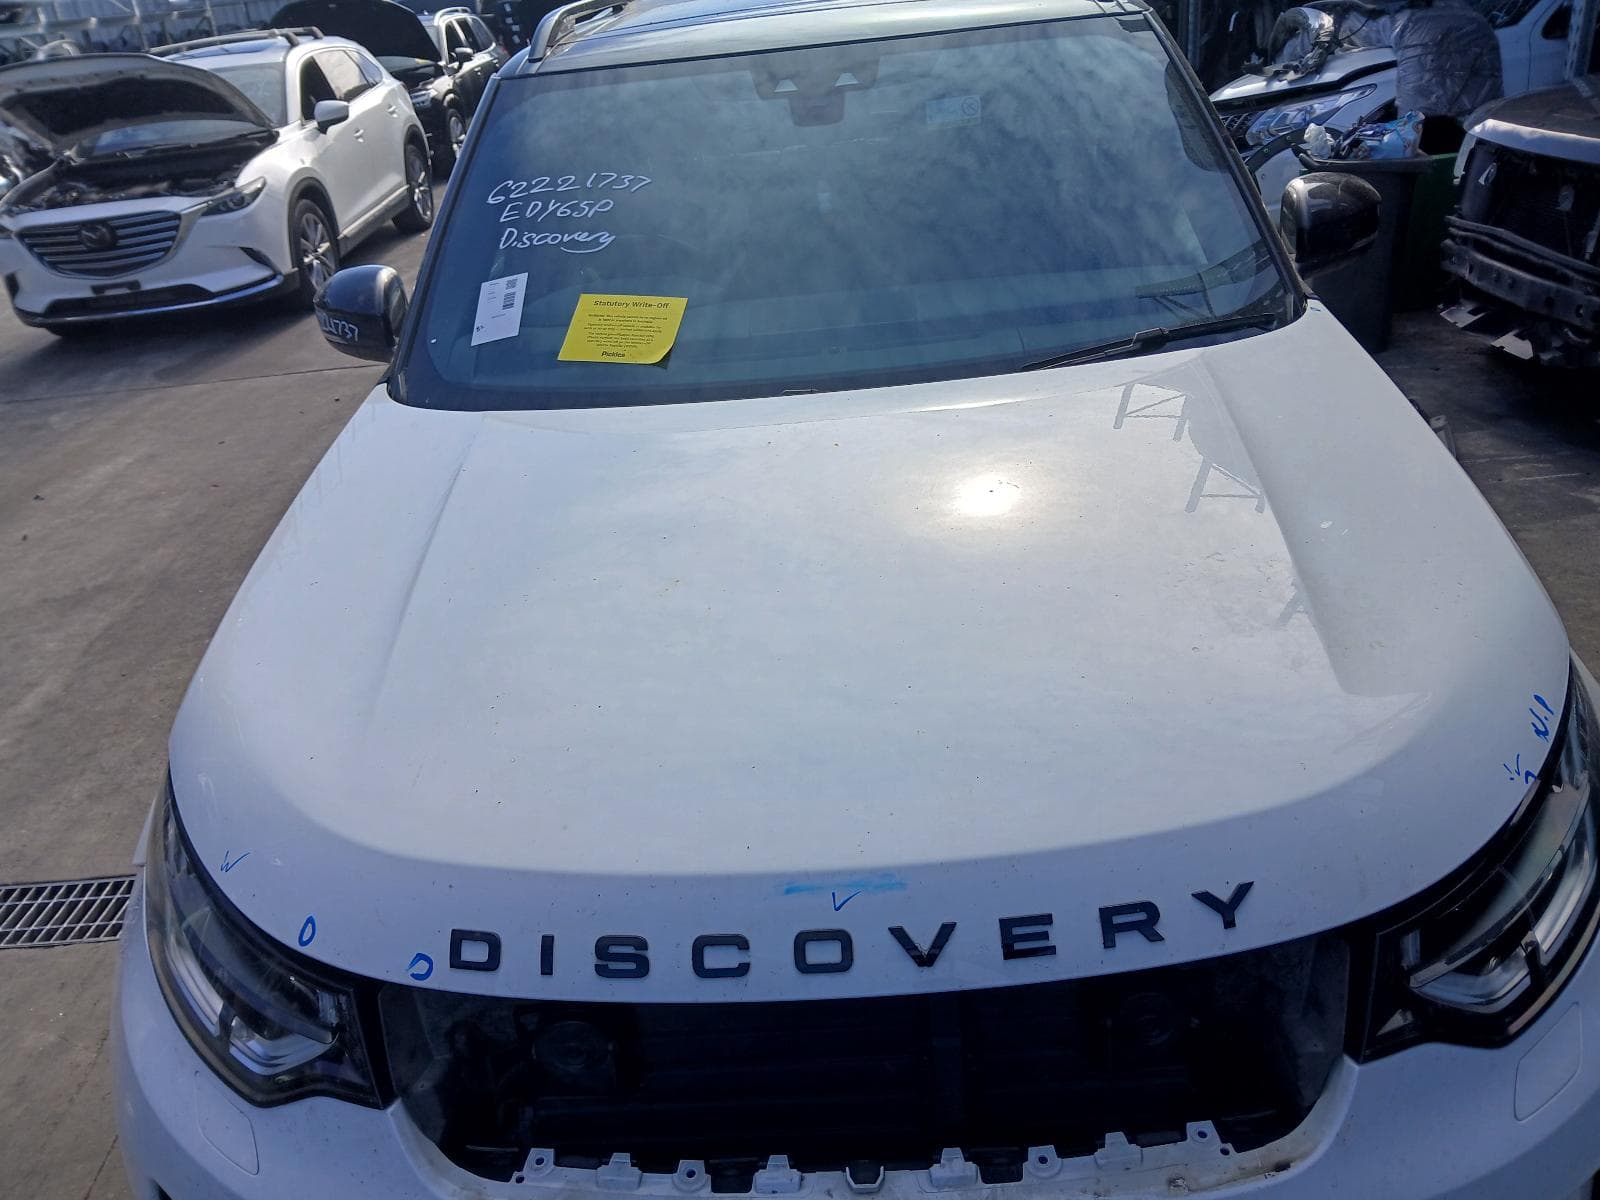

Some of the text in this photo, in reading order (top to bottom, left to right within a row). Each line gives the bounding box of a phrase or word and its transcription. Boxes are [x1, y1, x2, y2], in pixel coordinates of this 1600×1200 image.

[487, 173, 652, 204] 62221737
[499, 228, 616, 253] Discovery
[594, 300, 671, 309] Statutory Write-Off
[449, 881, 1254, 979] DISCOVERY
